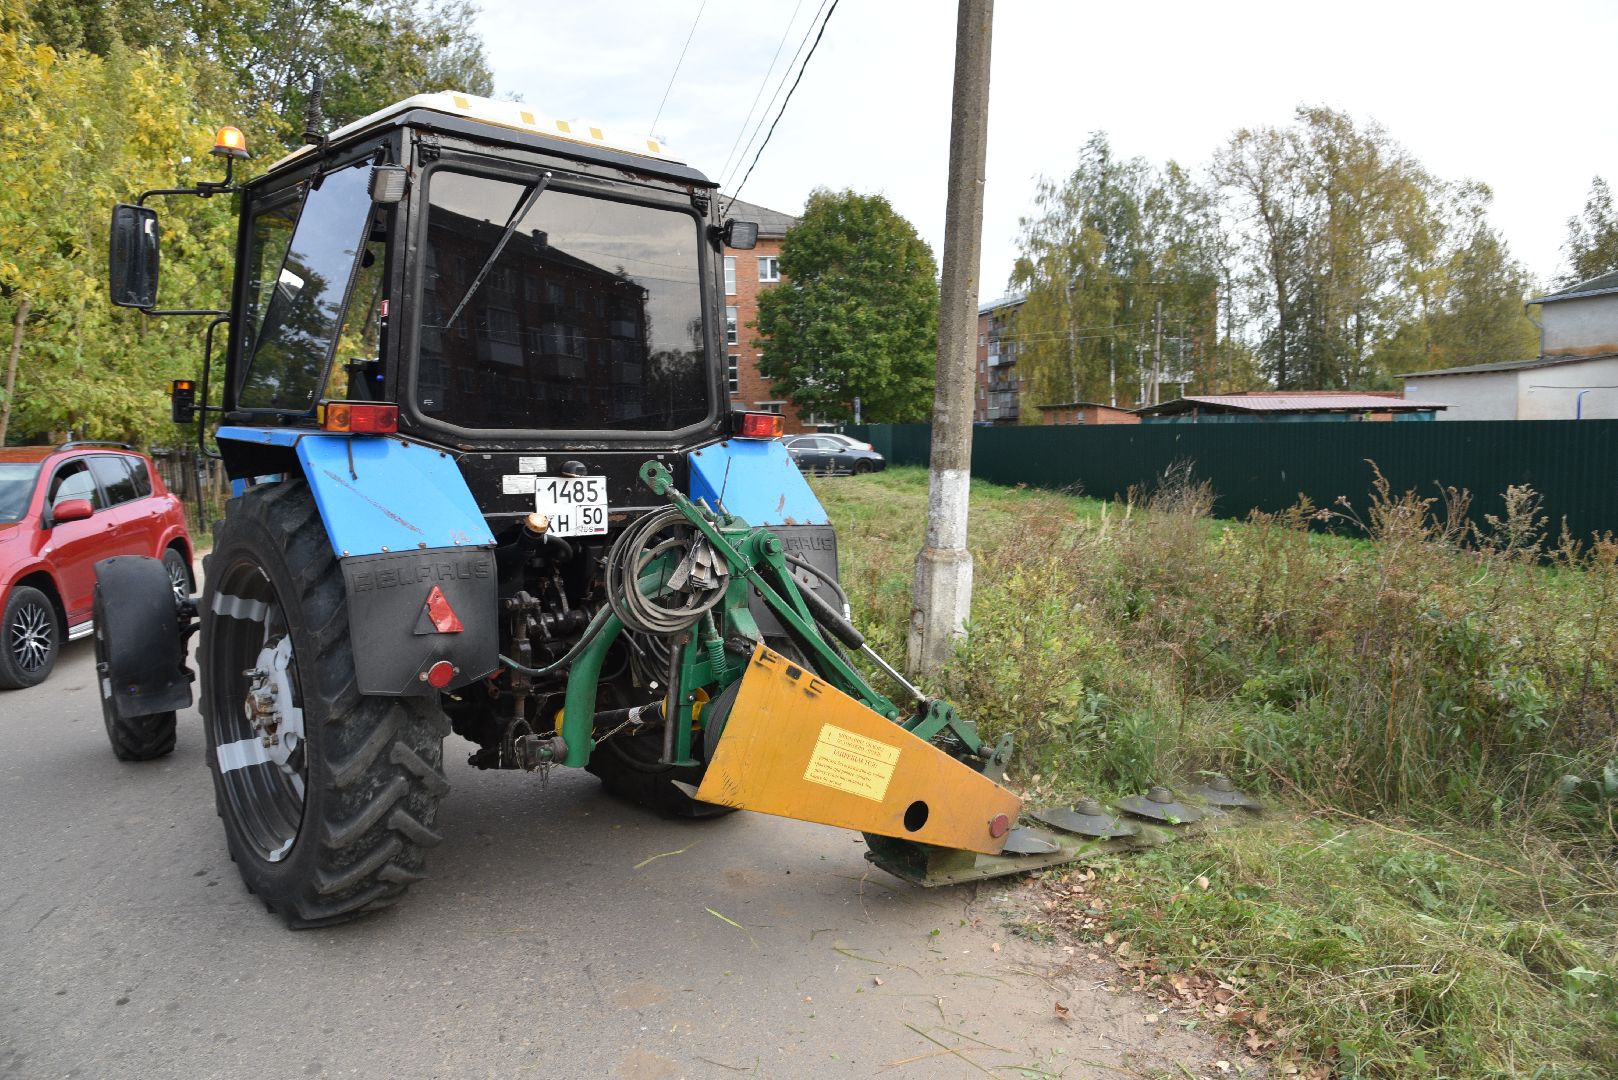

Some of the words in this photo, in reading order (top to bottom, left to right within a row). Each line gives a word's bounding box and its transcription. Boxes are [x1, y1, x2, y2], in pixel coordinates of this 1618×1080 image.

[547, 480, 598, 504] 1485
[583, 507, 603, 525] 50
[351, 560, 490, 593] BELARUS
